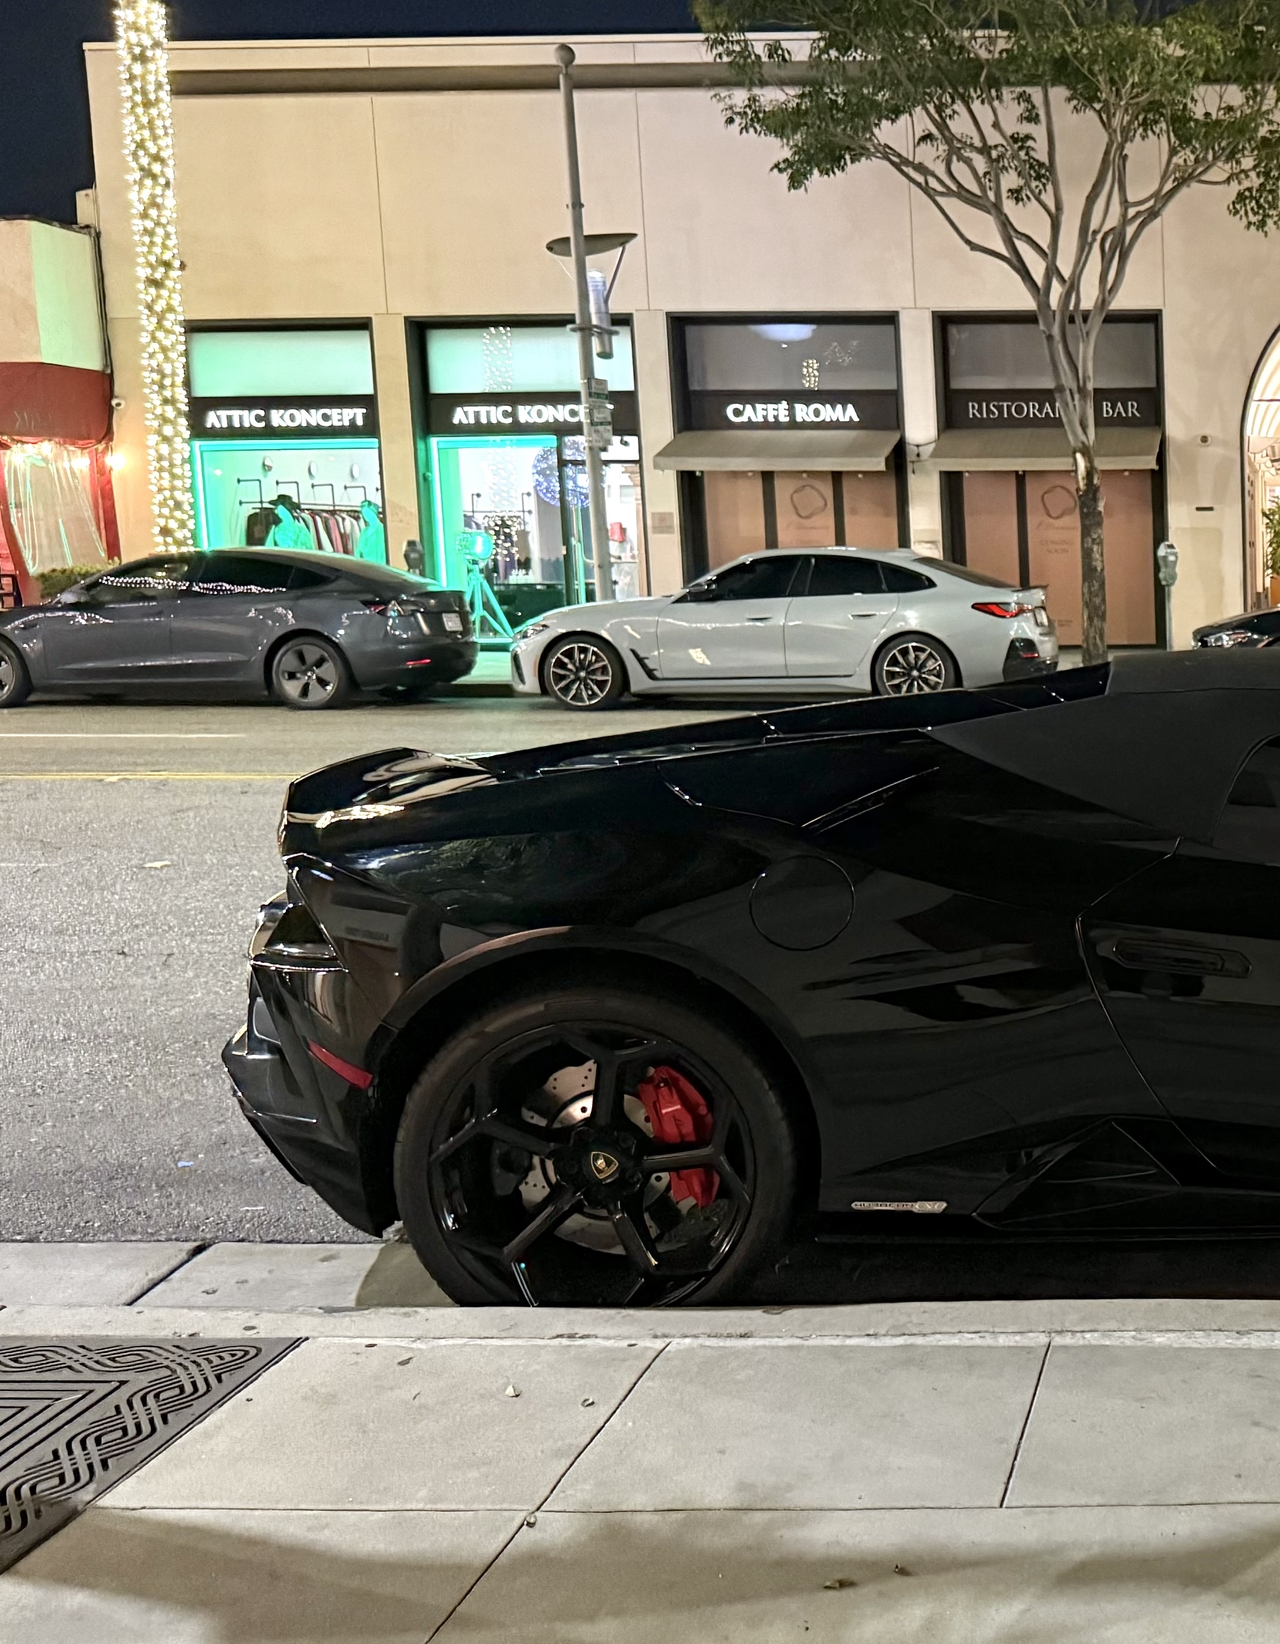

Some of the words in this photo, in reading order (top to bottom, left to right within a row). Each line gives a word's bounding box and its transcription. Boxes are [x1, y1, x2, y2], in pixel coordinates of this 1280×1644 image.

[206, 410, 265, 428] ATTIC
[271, 408, 367, 428] KONCEPT
[452, 405, 513, 424] ATTIC
[517, 404, 614, 424] KONC
[795, 404, 860, 422] ROMA
[968, 401, 1061, 418] RISTORA
[1102, 401, 1141, 418] BAR
